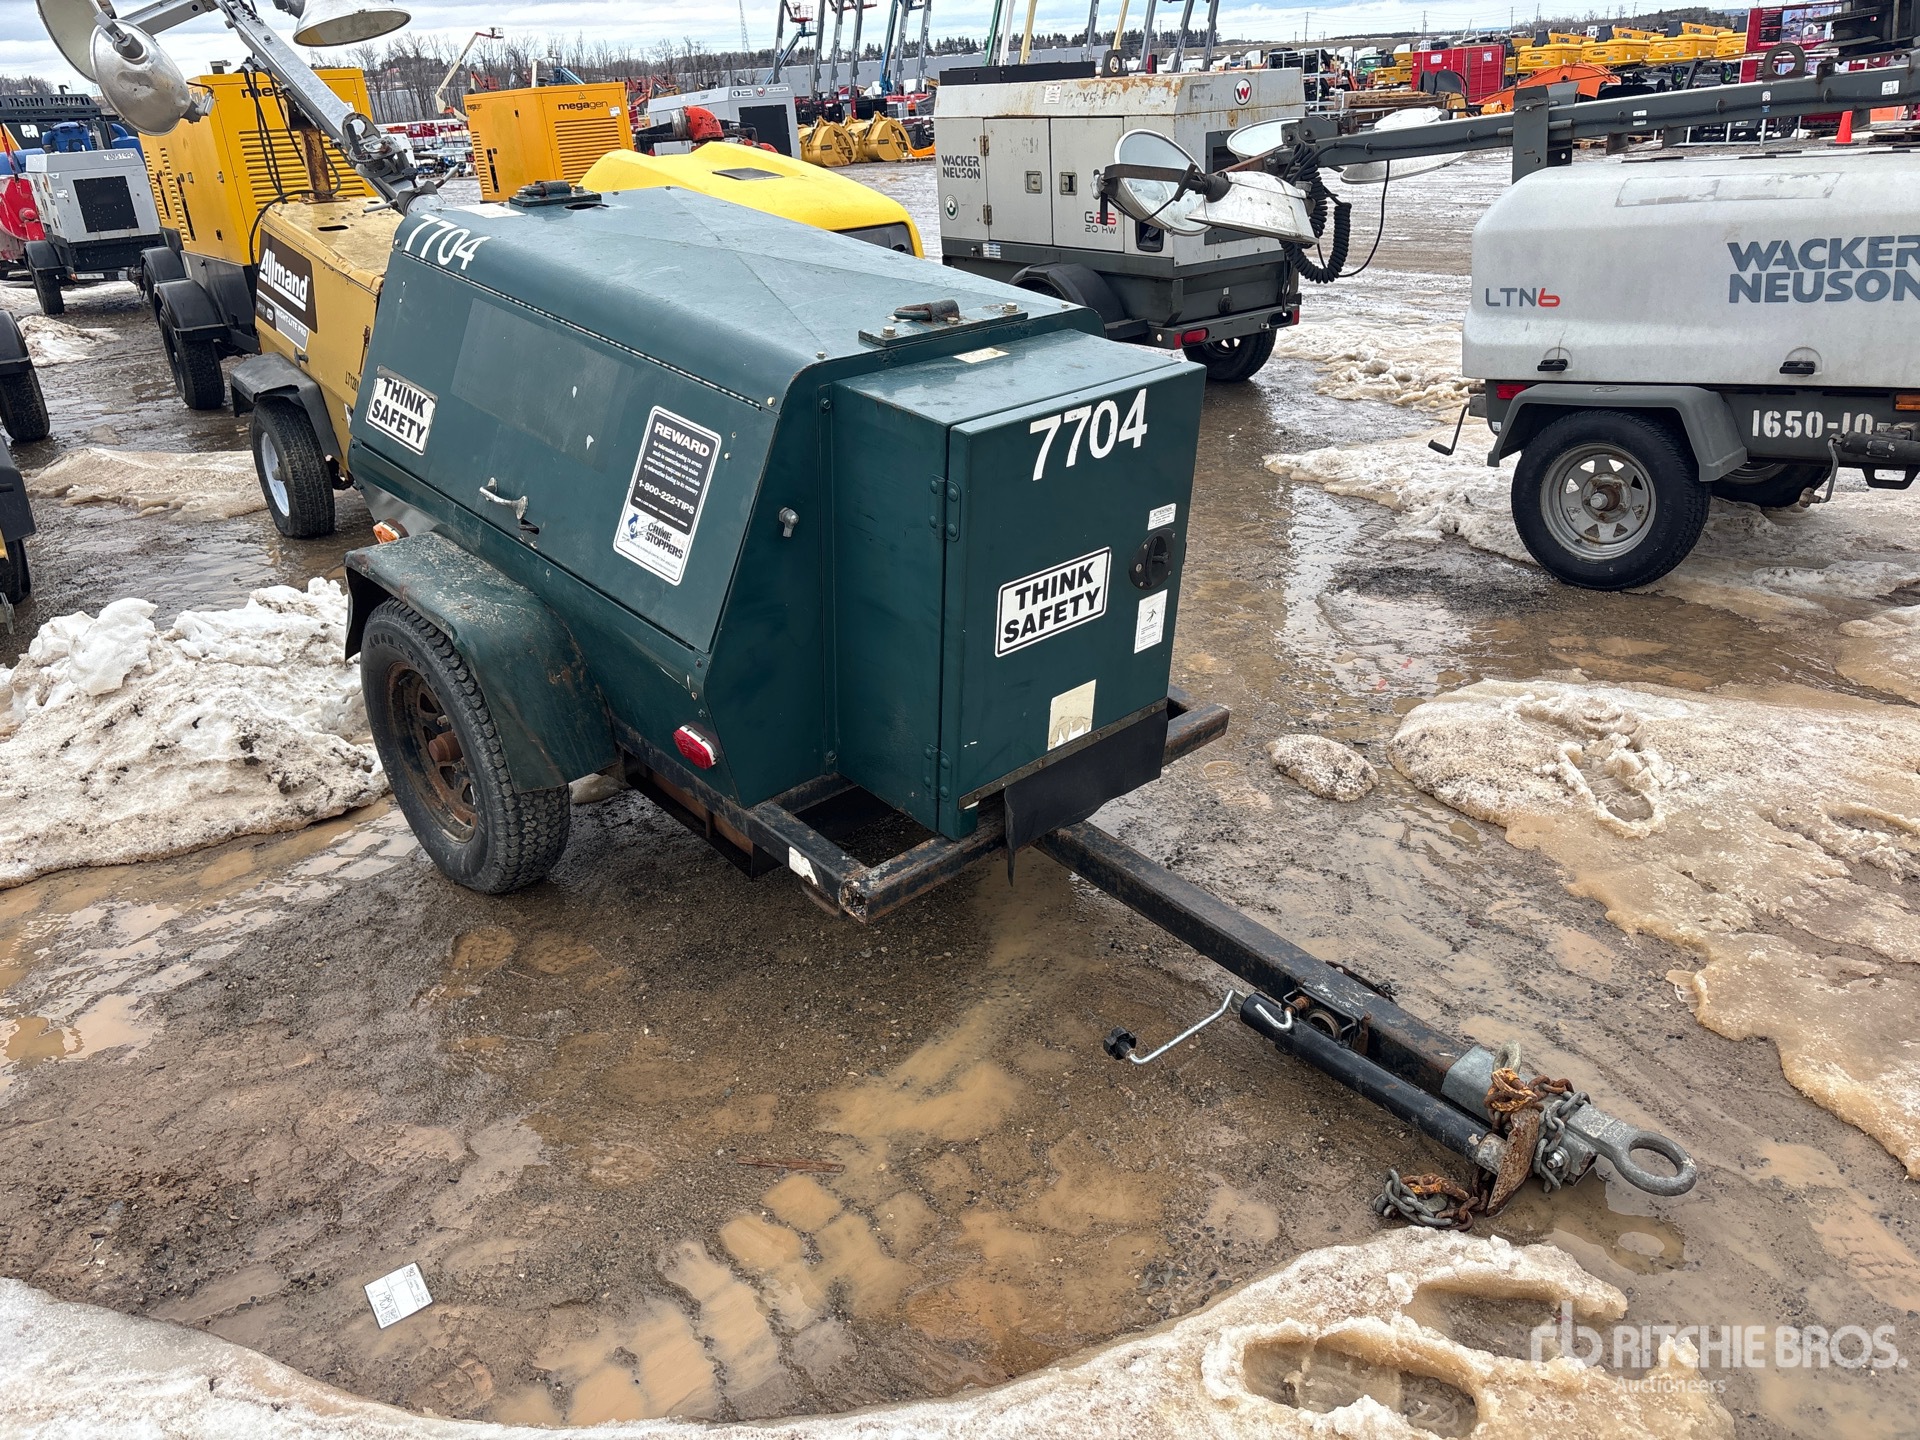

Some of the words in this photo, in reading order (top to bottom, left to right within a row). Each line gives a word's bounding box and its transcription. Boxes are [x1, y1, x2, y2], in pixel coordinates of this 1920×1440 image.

[558, 101, 609, 111] megagen
[941, 155, 980, 167] WACKER
[943, 167, 981, 179] NEUSON
[405, 213, 492, 270] 7704
[1085, 225, 1098, 233] 20
[1727, 235, 1920, 271] WACKER
[260, 248, 310, 303] Allmand
[1729, 269, 1920, 304] NEUSON
[1486, 287, 1561, 308] LTN6
[384, 378, 427, 418] THINK
[372, 399, 426, 443] SAFETY
[1029, 388, 1148, 481] 7704
[654, 422, 710, 457] REWARD
[638, 480, 695, 515] 1-800-222-TIPS
[644, 533, 684, 560] STOPPERS
[647, 522, 673, 542] CRIME
[1015, 561, 1095, 611] THINK
[1004, 586, 1102, 644] SAFETY
